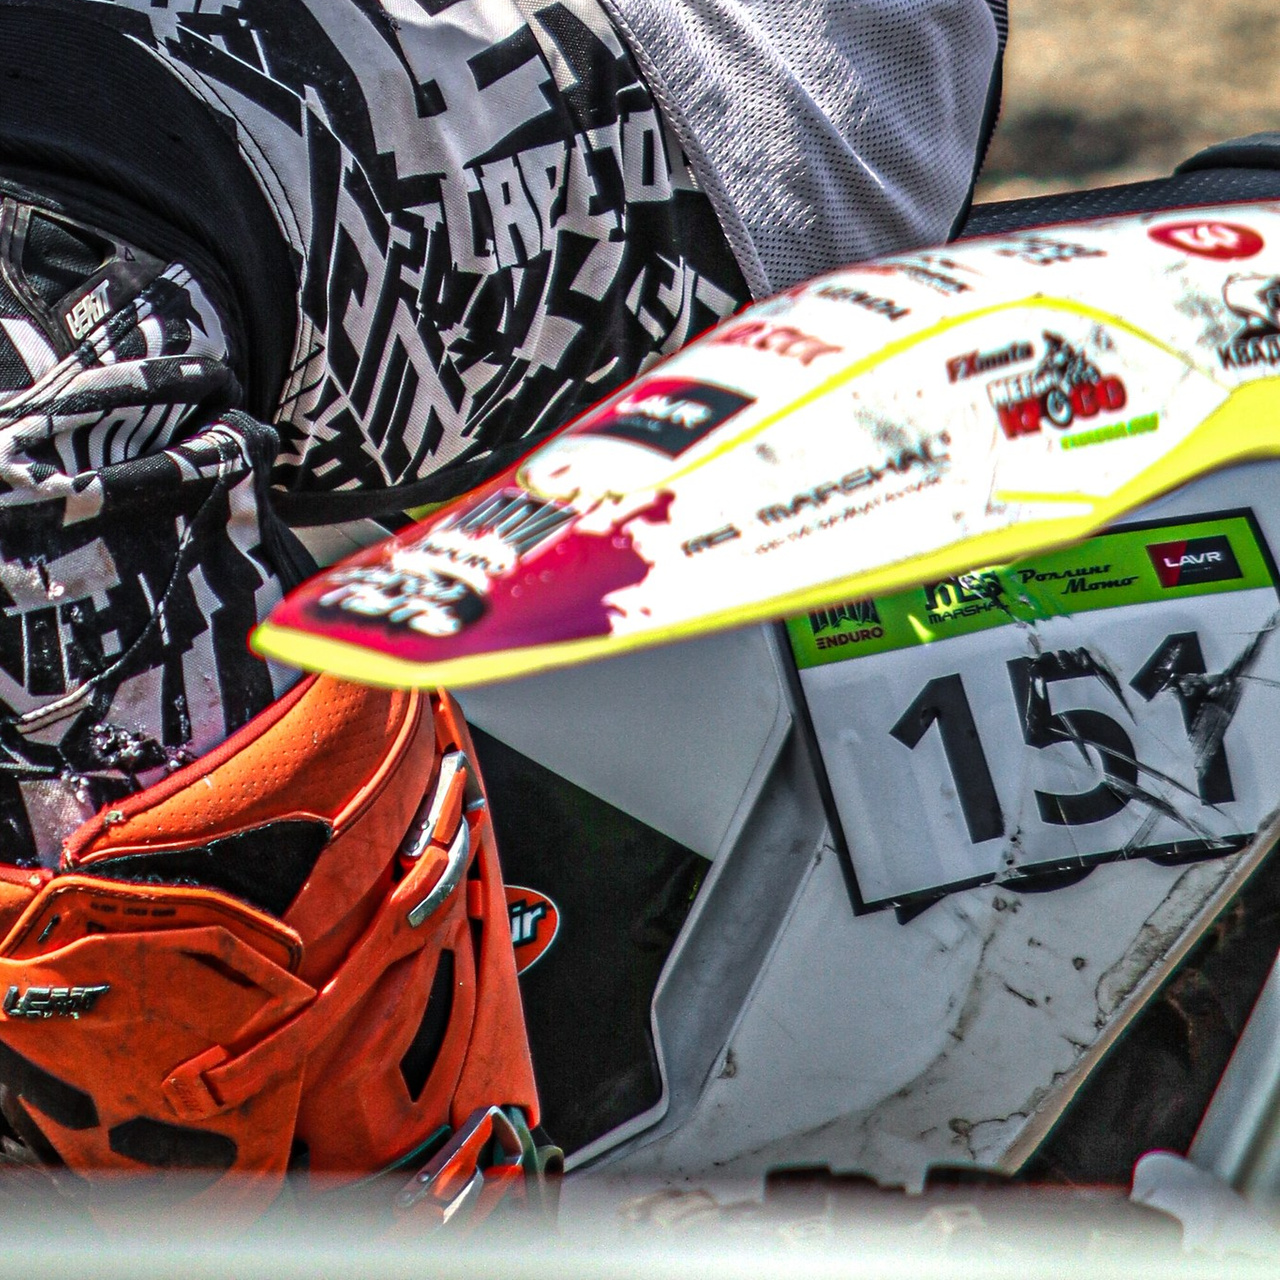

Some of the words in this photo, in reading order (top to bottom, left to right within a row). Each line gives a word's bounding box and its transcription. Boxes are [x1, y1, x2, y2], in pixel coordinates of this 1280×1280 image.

[1163, 551, 1221, 567] LAVR
[815, 628, 883, 650] ENDURO
[889, 630, 1235, 844] 151
